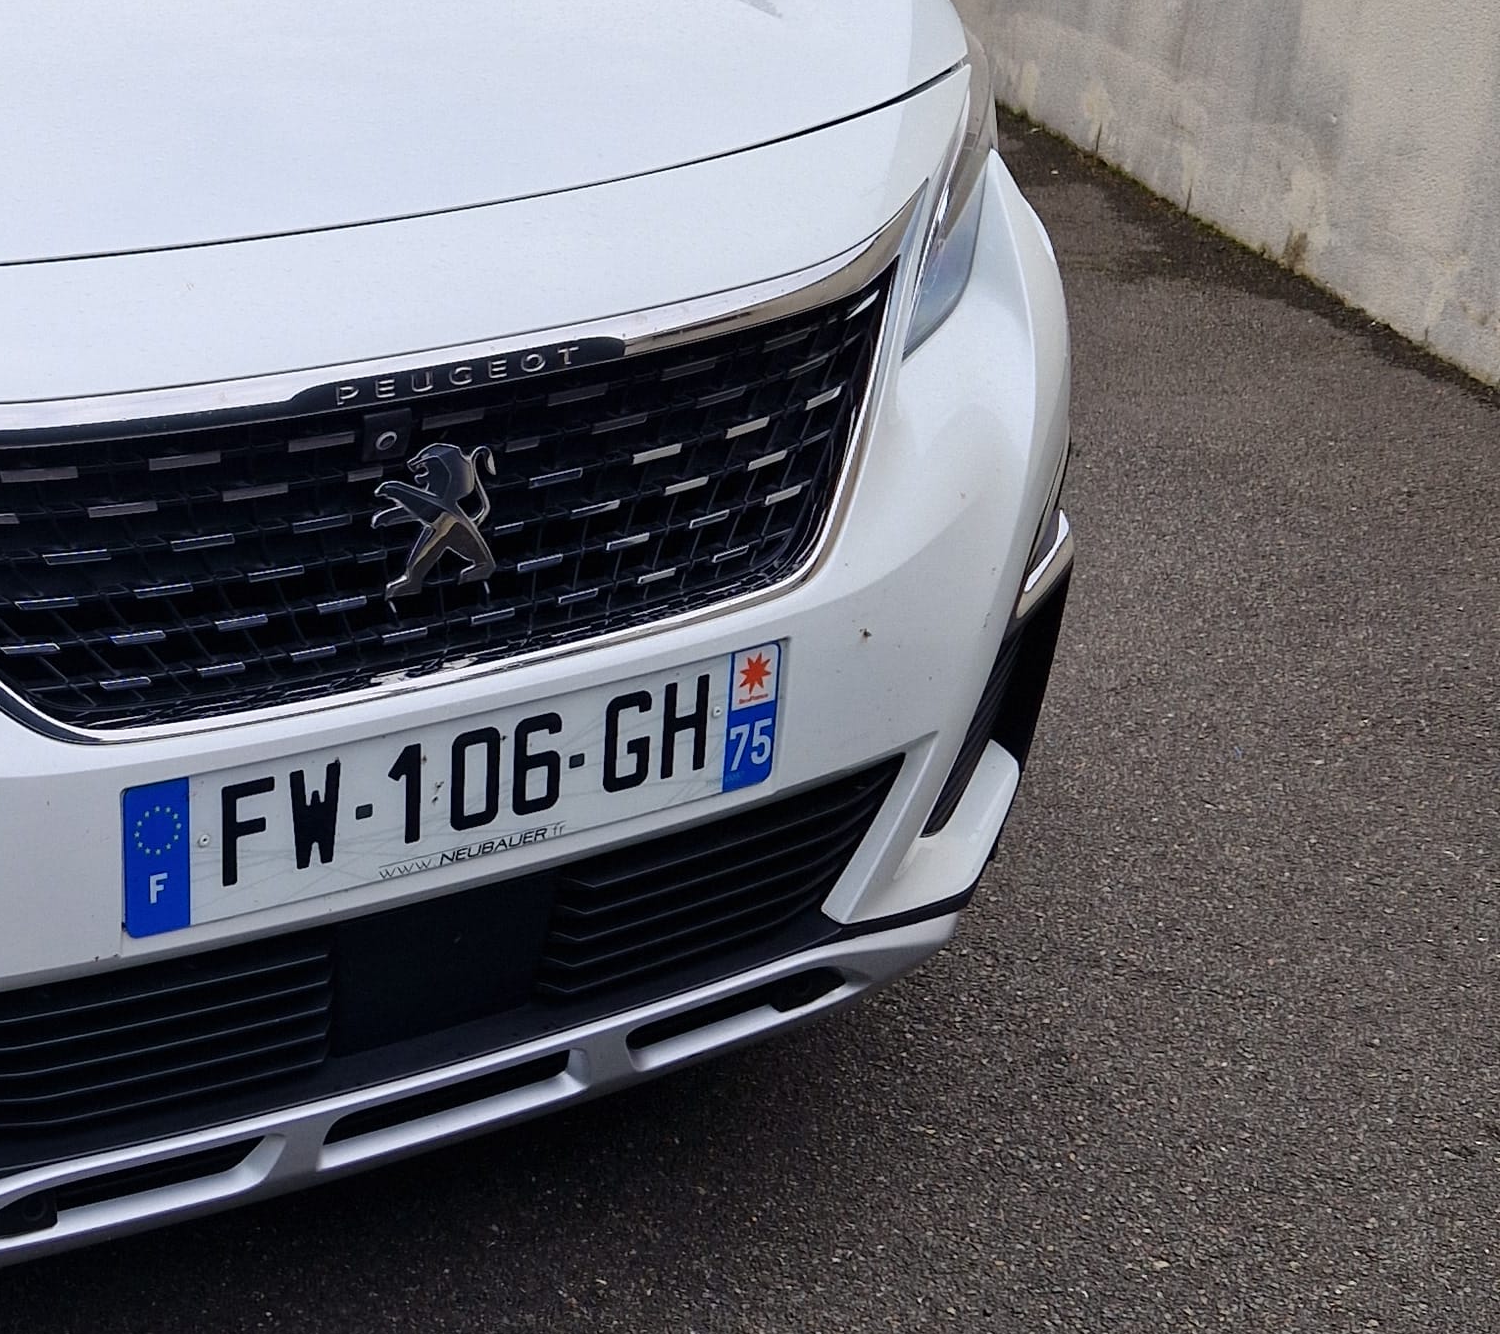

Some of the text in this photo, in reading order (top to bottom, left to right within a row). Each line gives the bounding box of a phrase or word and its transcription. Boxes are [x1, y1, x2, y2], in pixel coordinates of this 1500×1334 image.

[336, 346, 579, 405] PEUGEOT
[729, 717, 773, 772] 75
[221, 673, 710, 887] FW-106-GH
[149, 872, 168, 905] F
